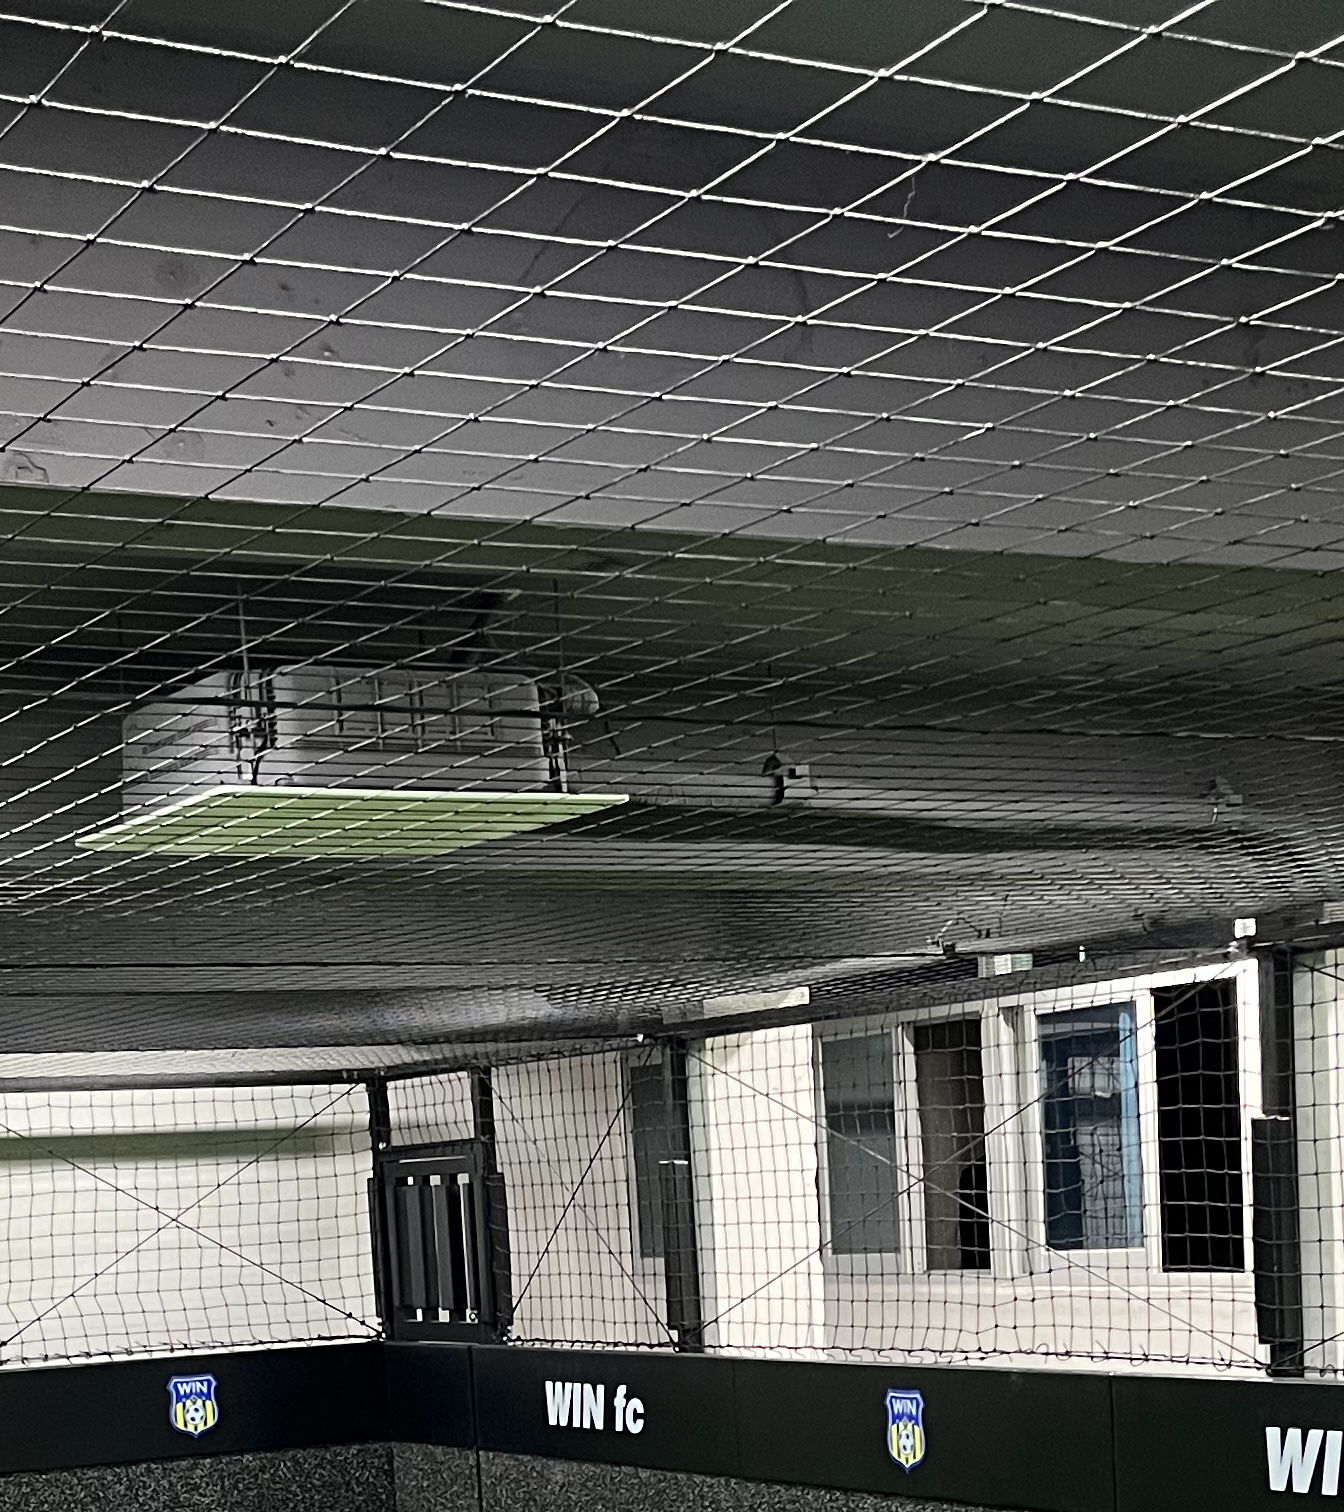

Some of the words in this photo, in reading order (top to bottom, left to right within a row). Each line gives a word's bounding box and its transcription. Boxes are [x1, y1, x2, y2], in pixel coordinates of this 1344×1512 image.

[177, 1381, 208, 1396] WIN
[545, 1381, 605, 1430] WIN
[614, 1384, 645, 1434] fc
[892, 1398, 917, 1416] WIN
